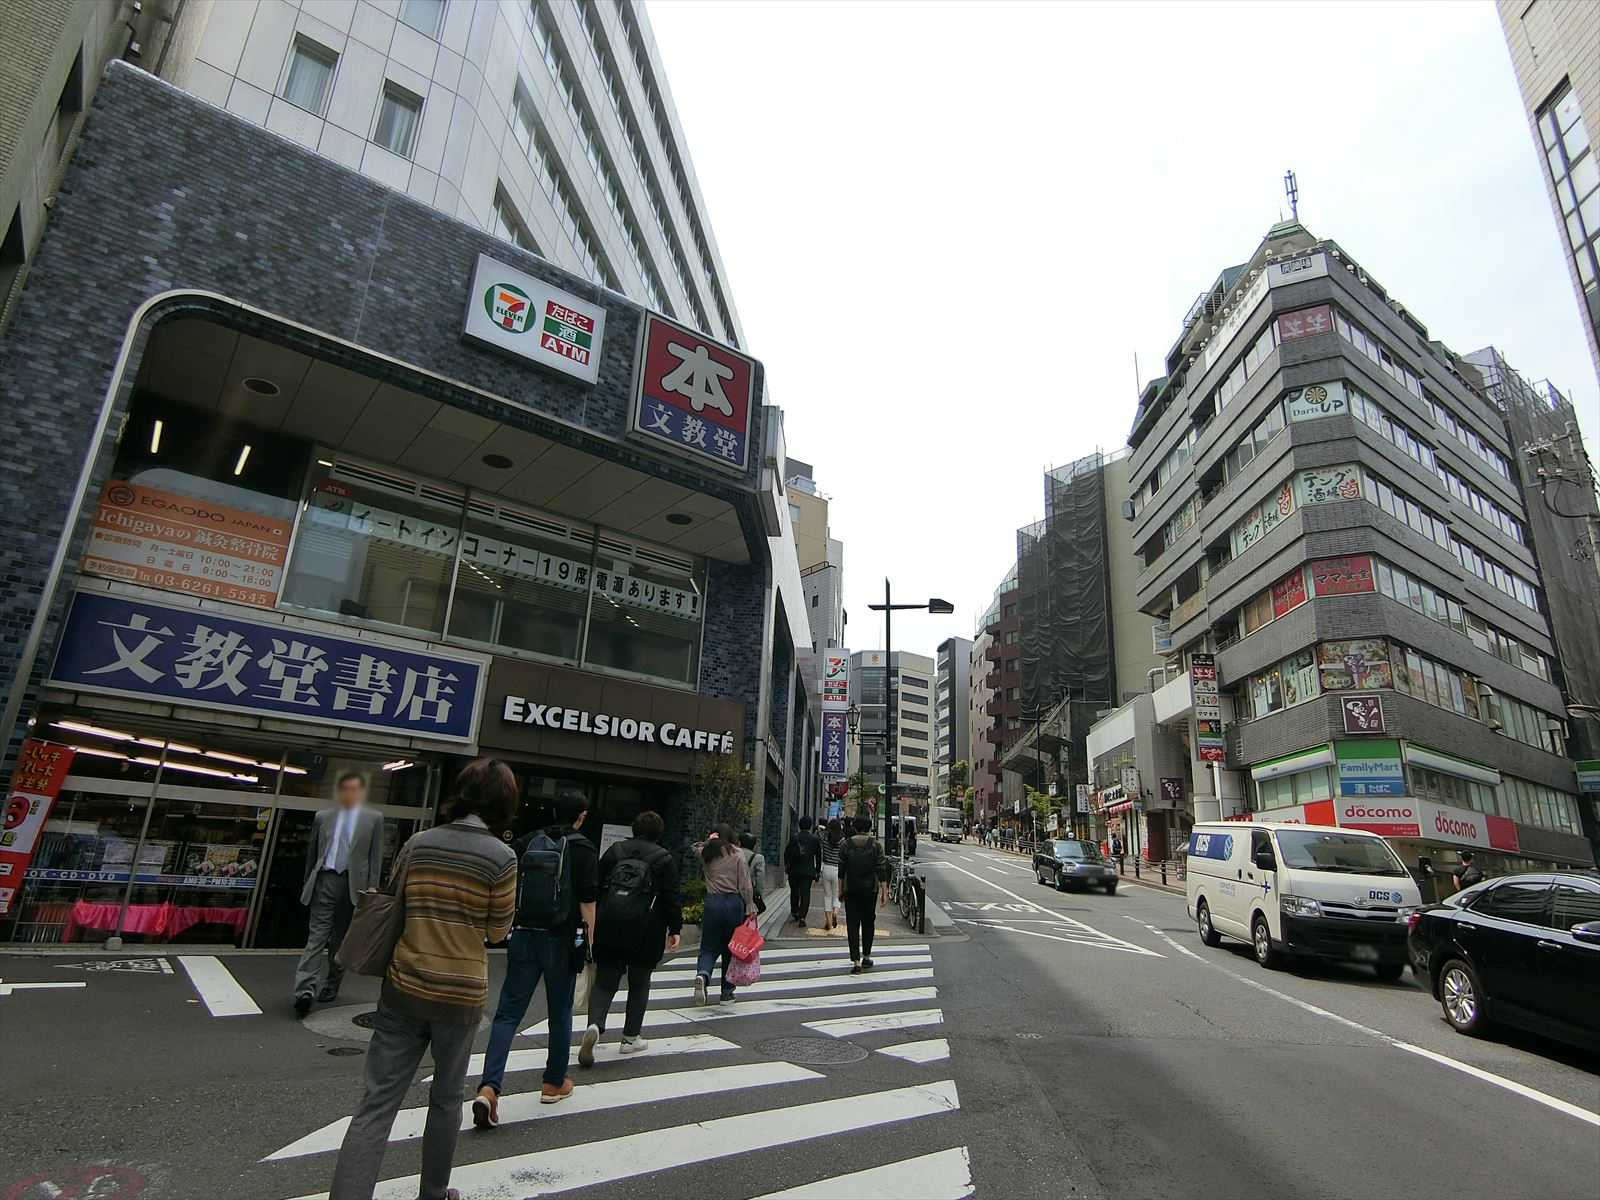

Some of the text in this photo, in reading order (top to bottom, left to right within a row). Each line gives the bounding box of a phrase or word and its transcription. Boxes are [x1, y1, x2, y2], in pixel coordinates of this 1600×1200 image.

[495, 306, 524, 323] ELEVEN
[551, 304, 589, 330] たばこ
[559, 324, 578, 343] 酒
[545, 336, 588, 364] ATM
[661, 341, 735, 418] 本
[1293, 400, 1344, 417] Darts UP
[646, 403, 738, 462] 文教堂
[98, 507, 191, 540] Ichigayaの
[140, 495, 271, 533] EGAODO JAPAN
[153, 572, 268, 605] 03-6261-5545
[82, 612, 460, 724] 文教堂書店
[503, 695, 656, 743] EXCELSIOR
[659, 722, 735, 755] CAFFÉ
[827, 716, 842, 730] 本
[826, 731, 841, 772] 文教堂
[1340, 762, 1400, 774] FamilyMart
[1354, 783, 1392, 794] 酒 たばこ
[1345, 805, 1413, 818] docomo
[1434, 809, 1477, 839] docomo
[88, 872, 116, 880] DVD
[1369, 890, 1391, 901] OCS
